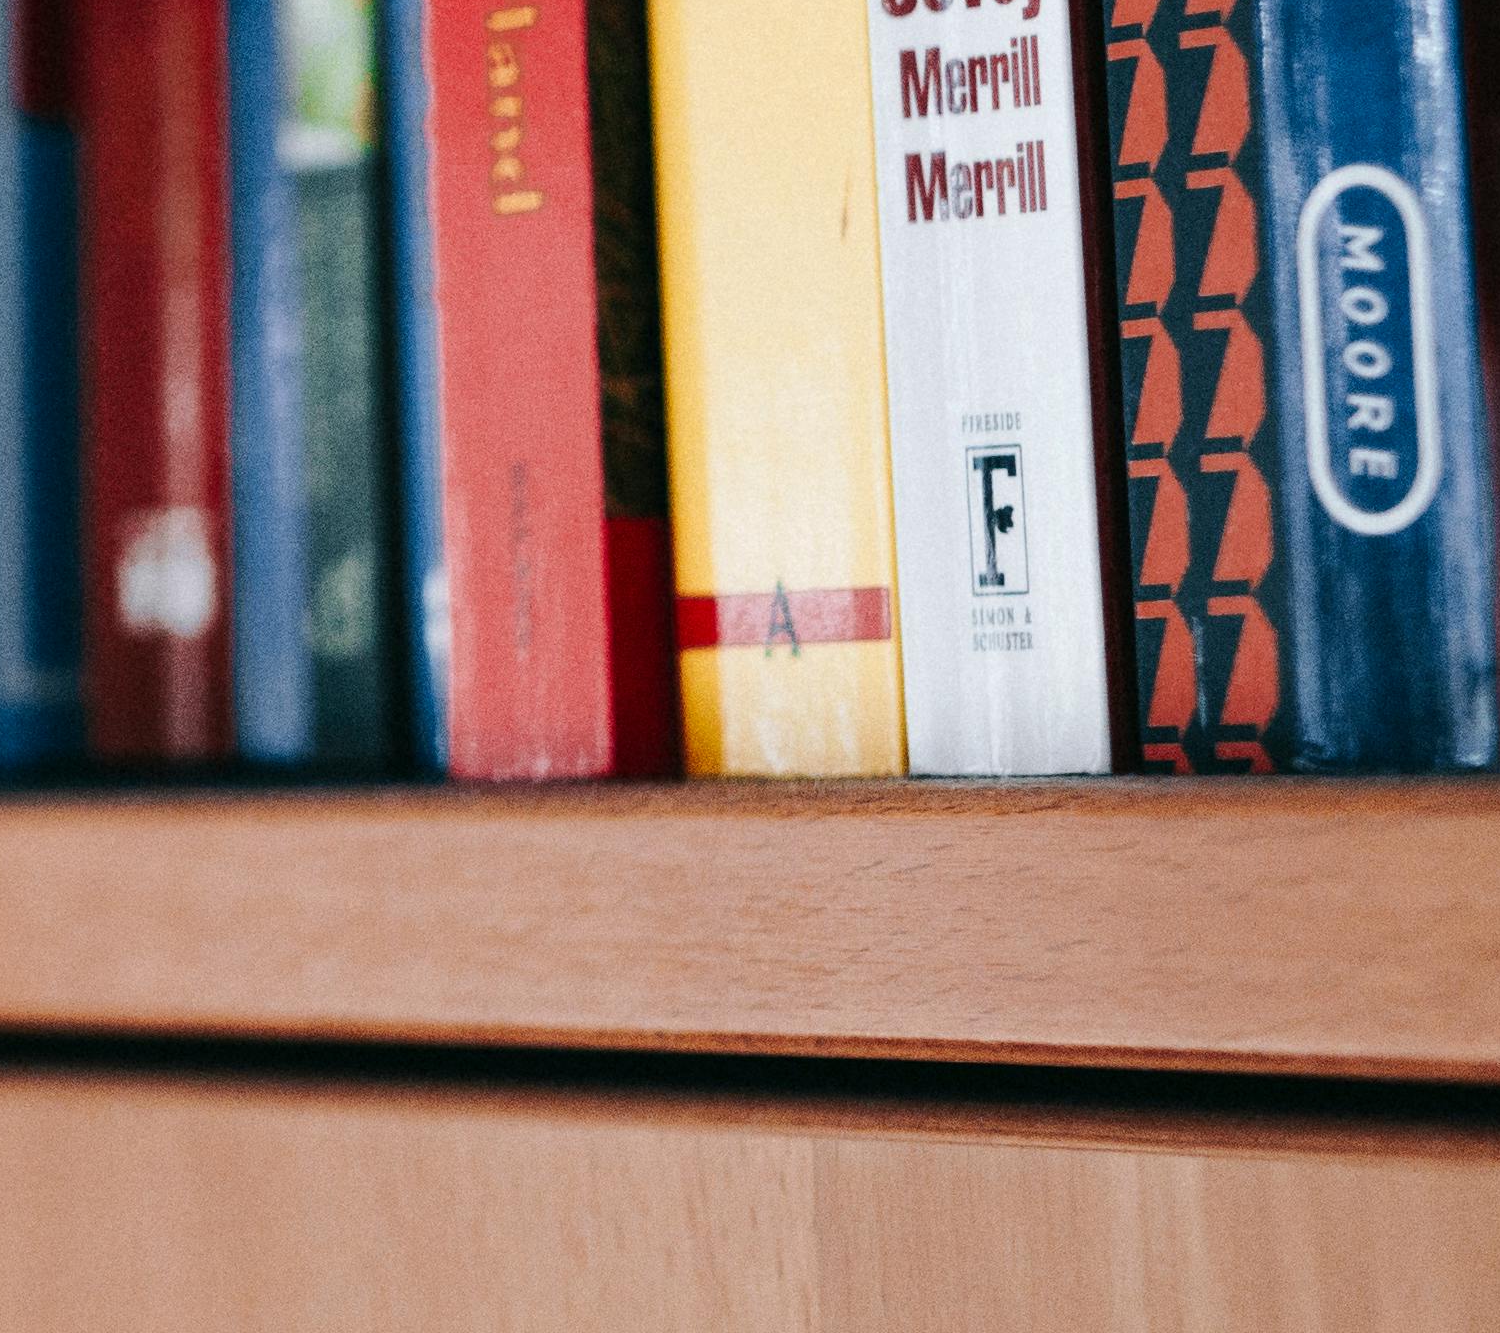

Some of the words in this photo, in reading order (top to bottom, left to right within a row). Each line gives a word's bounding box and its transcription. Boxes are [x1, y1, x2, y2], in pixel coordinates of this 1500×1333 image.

[899, 34, 1042, 120] Merrill
[904, 139, 1048, 224] Merrill
[1338, 222, 1396, 480] MOORE
[961, 411, 1022, 433] FIRESIDE
[971, 605, 1015, 626] SIMON
[972, 631, 1033, 652] SCHUSTER
